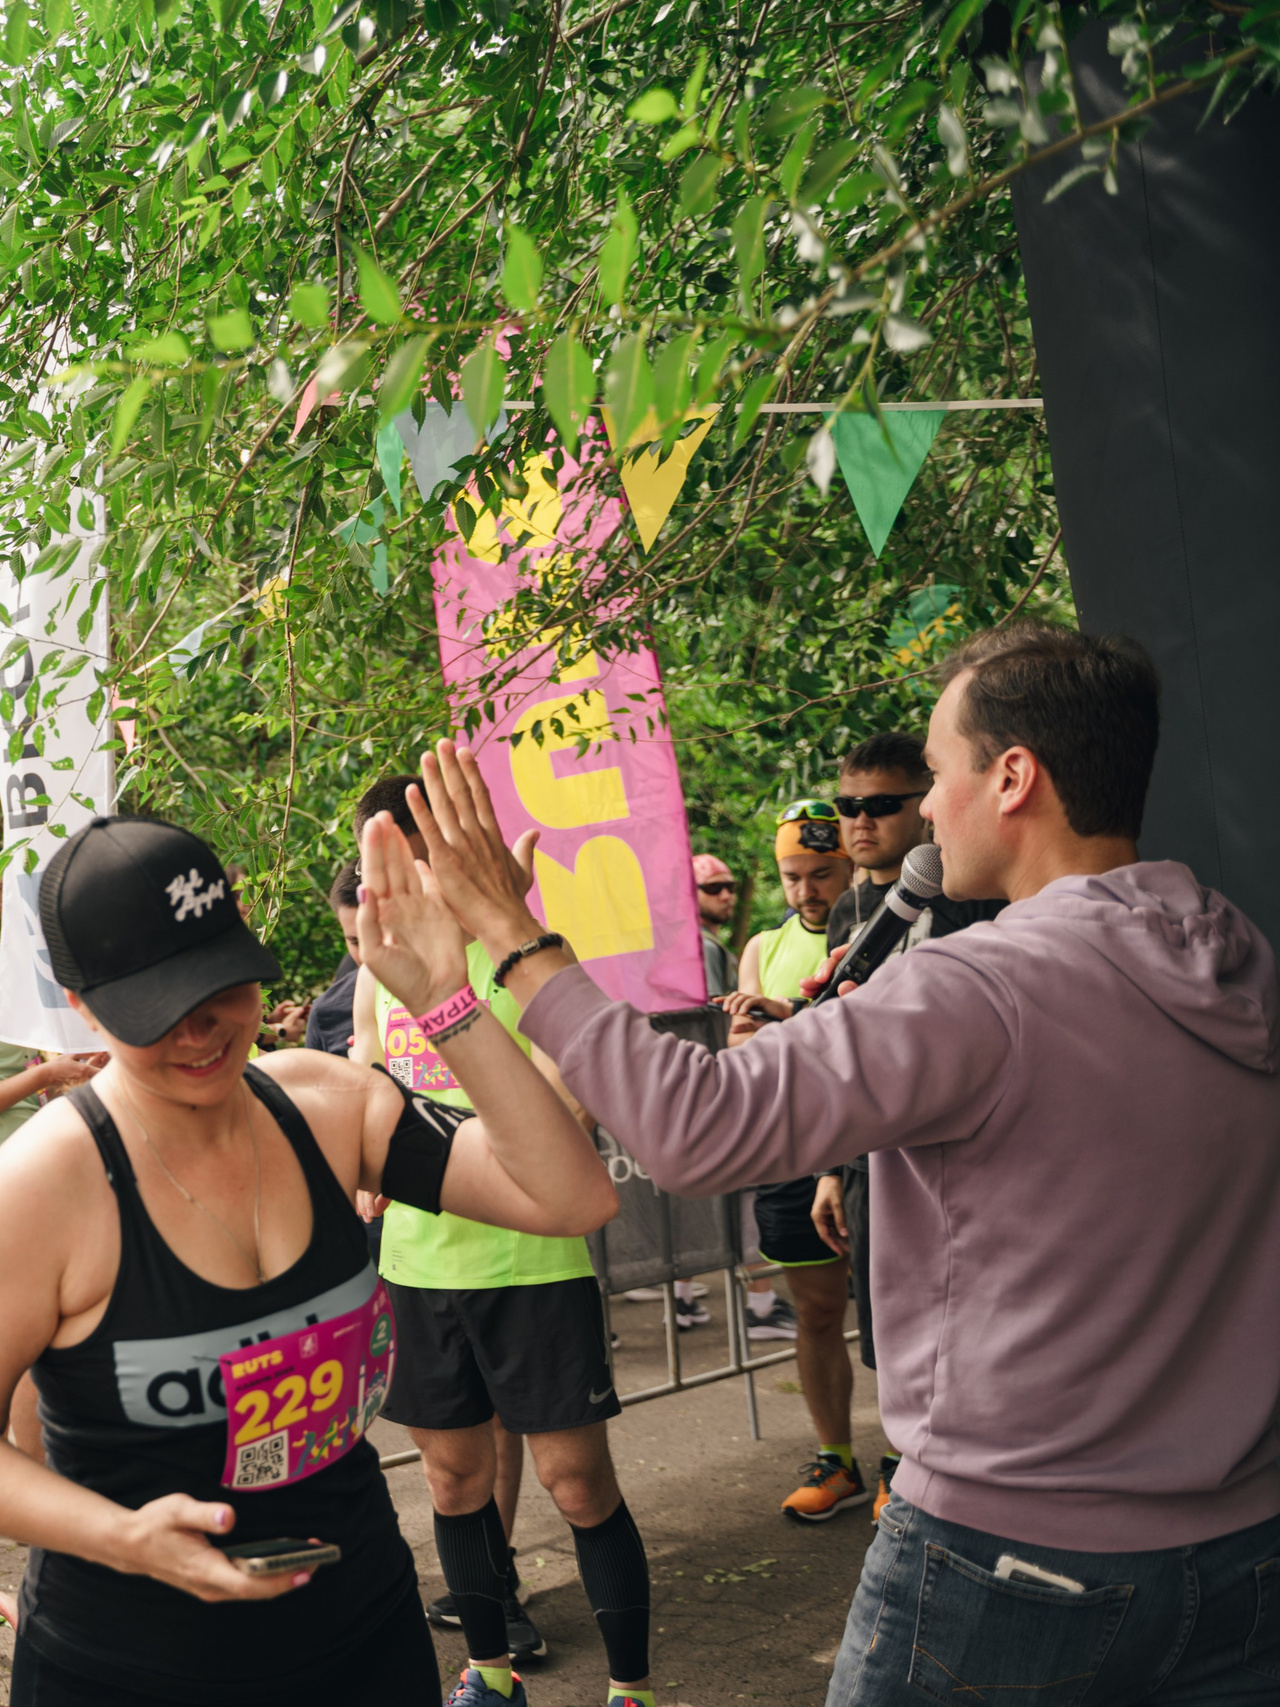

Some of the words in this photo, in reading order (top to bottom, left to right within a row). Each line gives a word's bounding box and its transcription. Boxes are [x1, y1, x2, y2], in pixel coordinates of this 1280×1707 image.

[376, 1320, 387, 1340] 2
[231, 1349, 284, 1379] RUTS
[234, 1359, 343, 1445] 229
